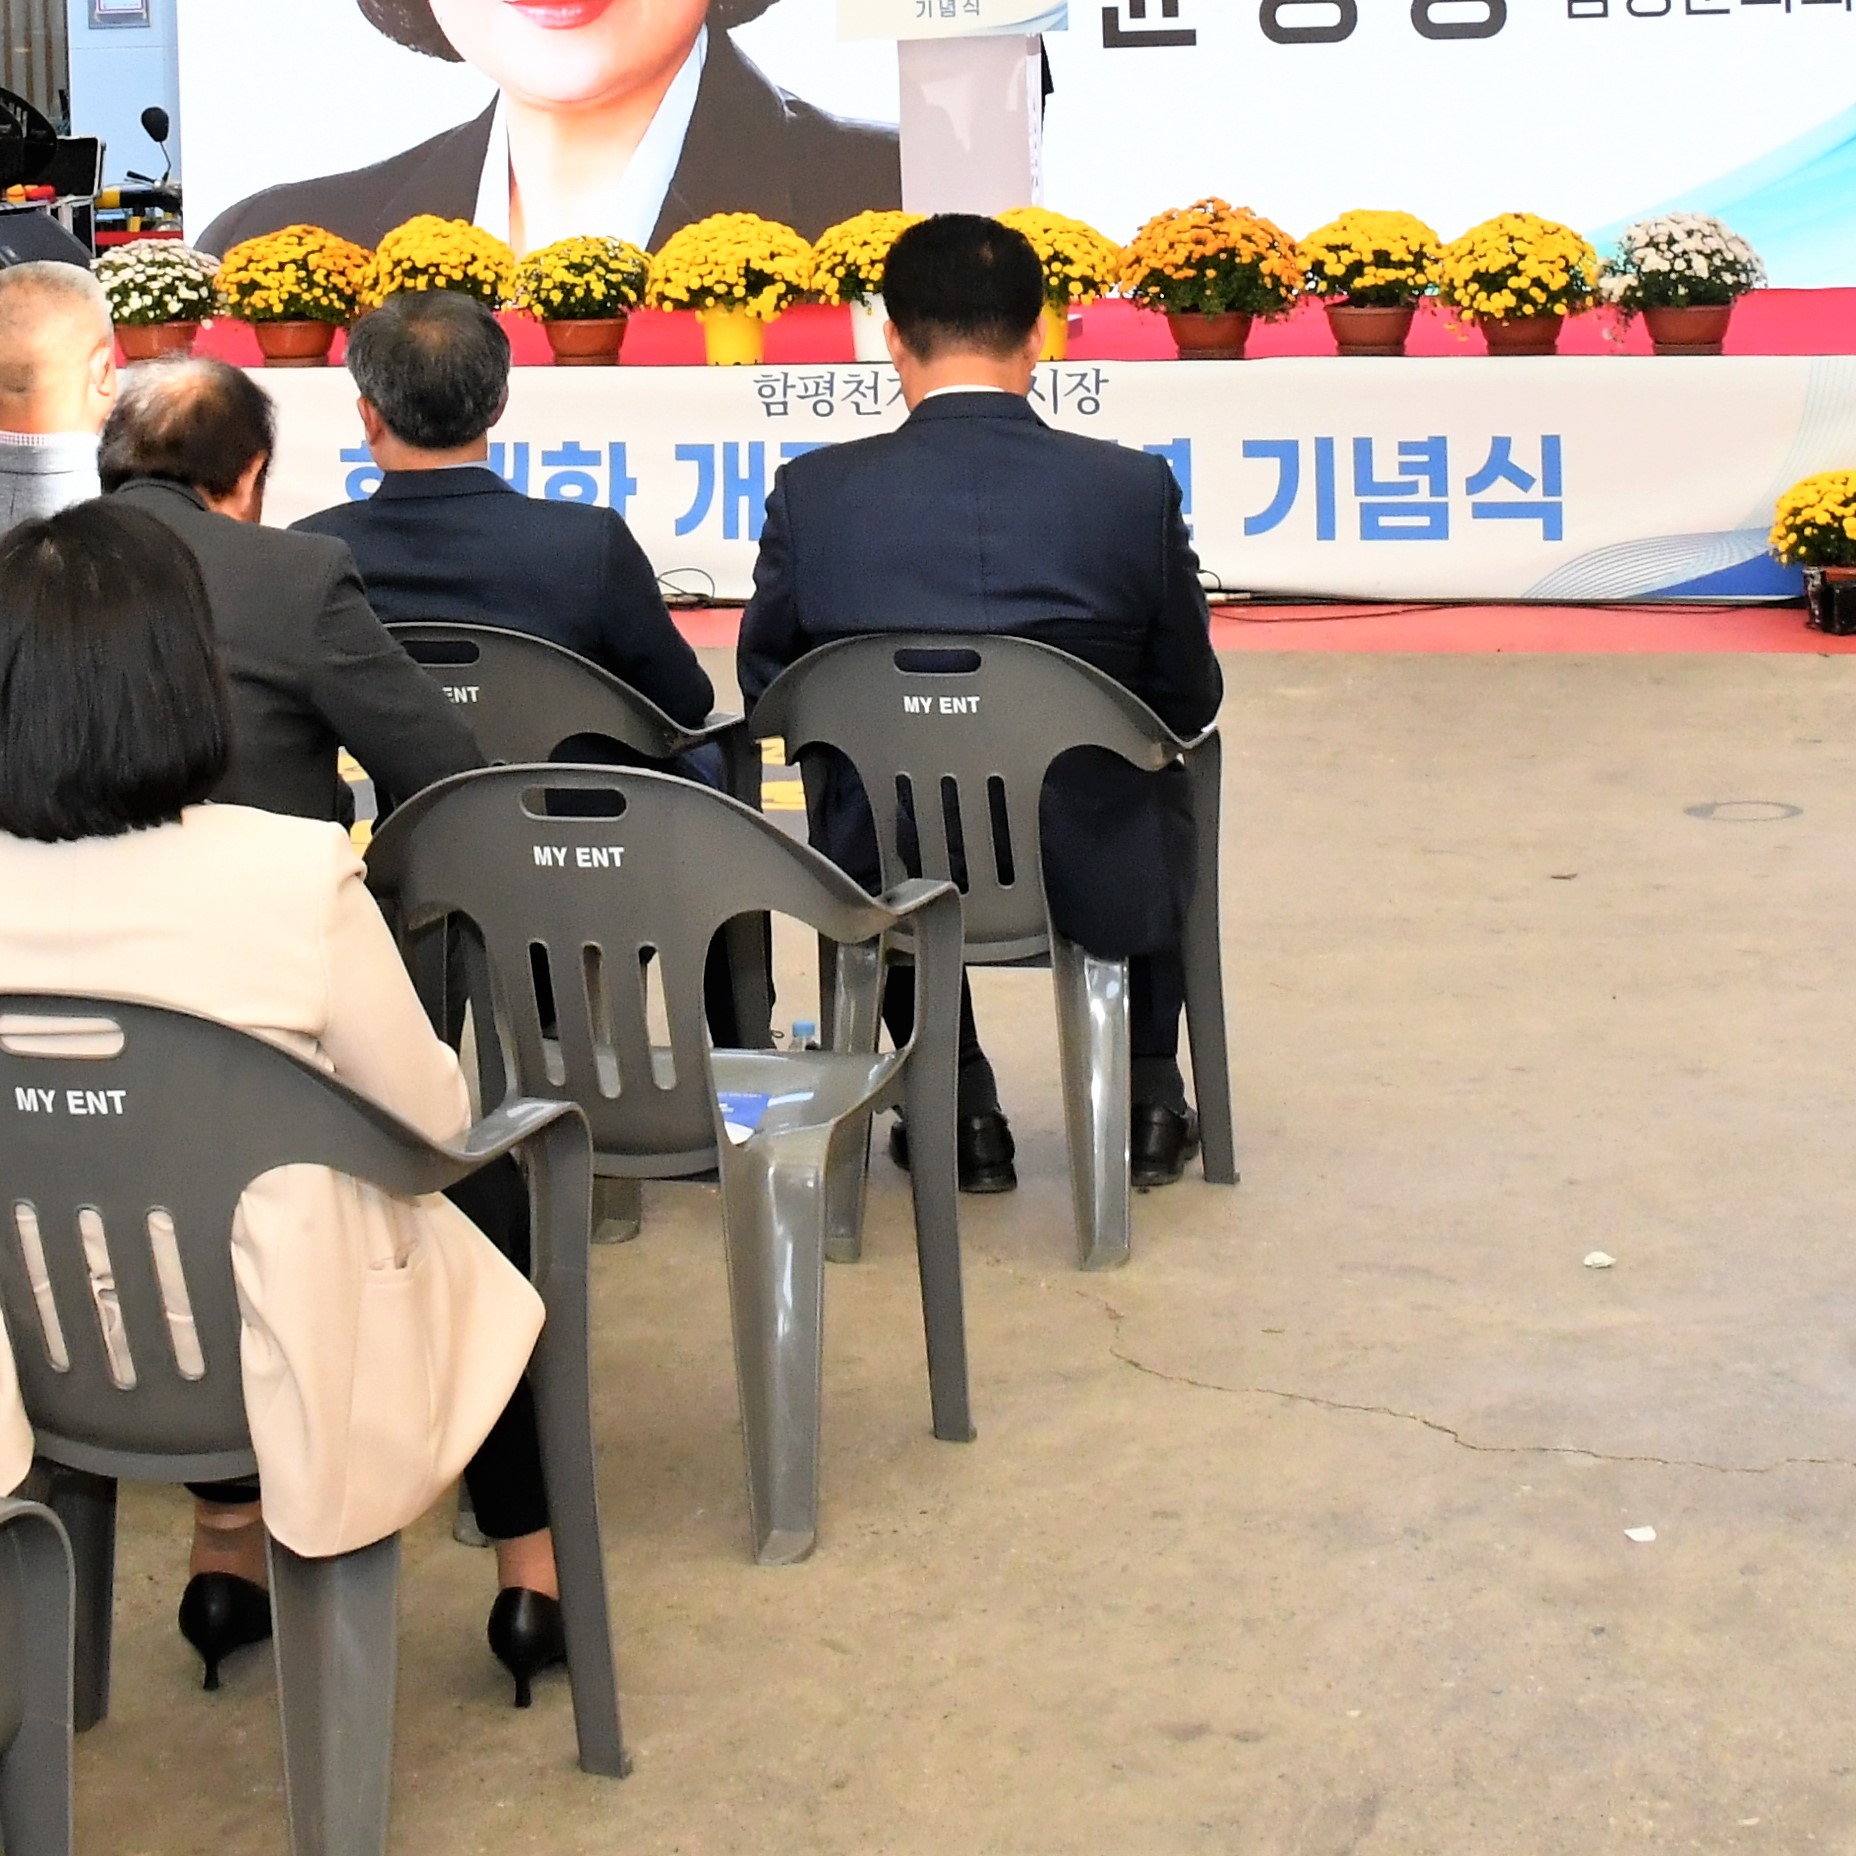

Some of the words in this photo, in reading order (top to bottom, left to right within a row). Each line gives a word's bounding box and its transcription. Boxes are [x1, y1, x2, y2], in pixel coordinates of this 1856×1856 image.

[1241, 435, 1567, 544] 기념식
[903, 695, 933, 714] MY
[939, 696, 981, 714] ENT
[532, 845, 568, 867] MY
[574, 845, 625, 868] ENT
[14, 1086, 56, 1114] MY
[65, 1089, 128, 1115] ENT
